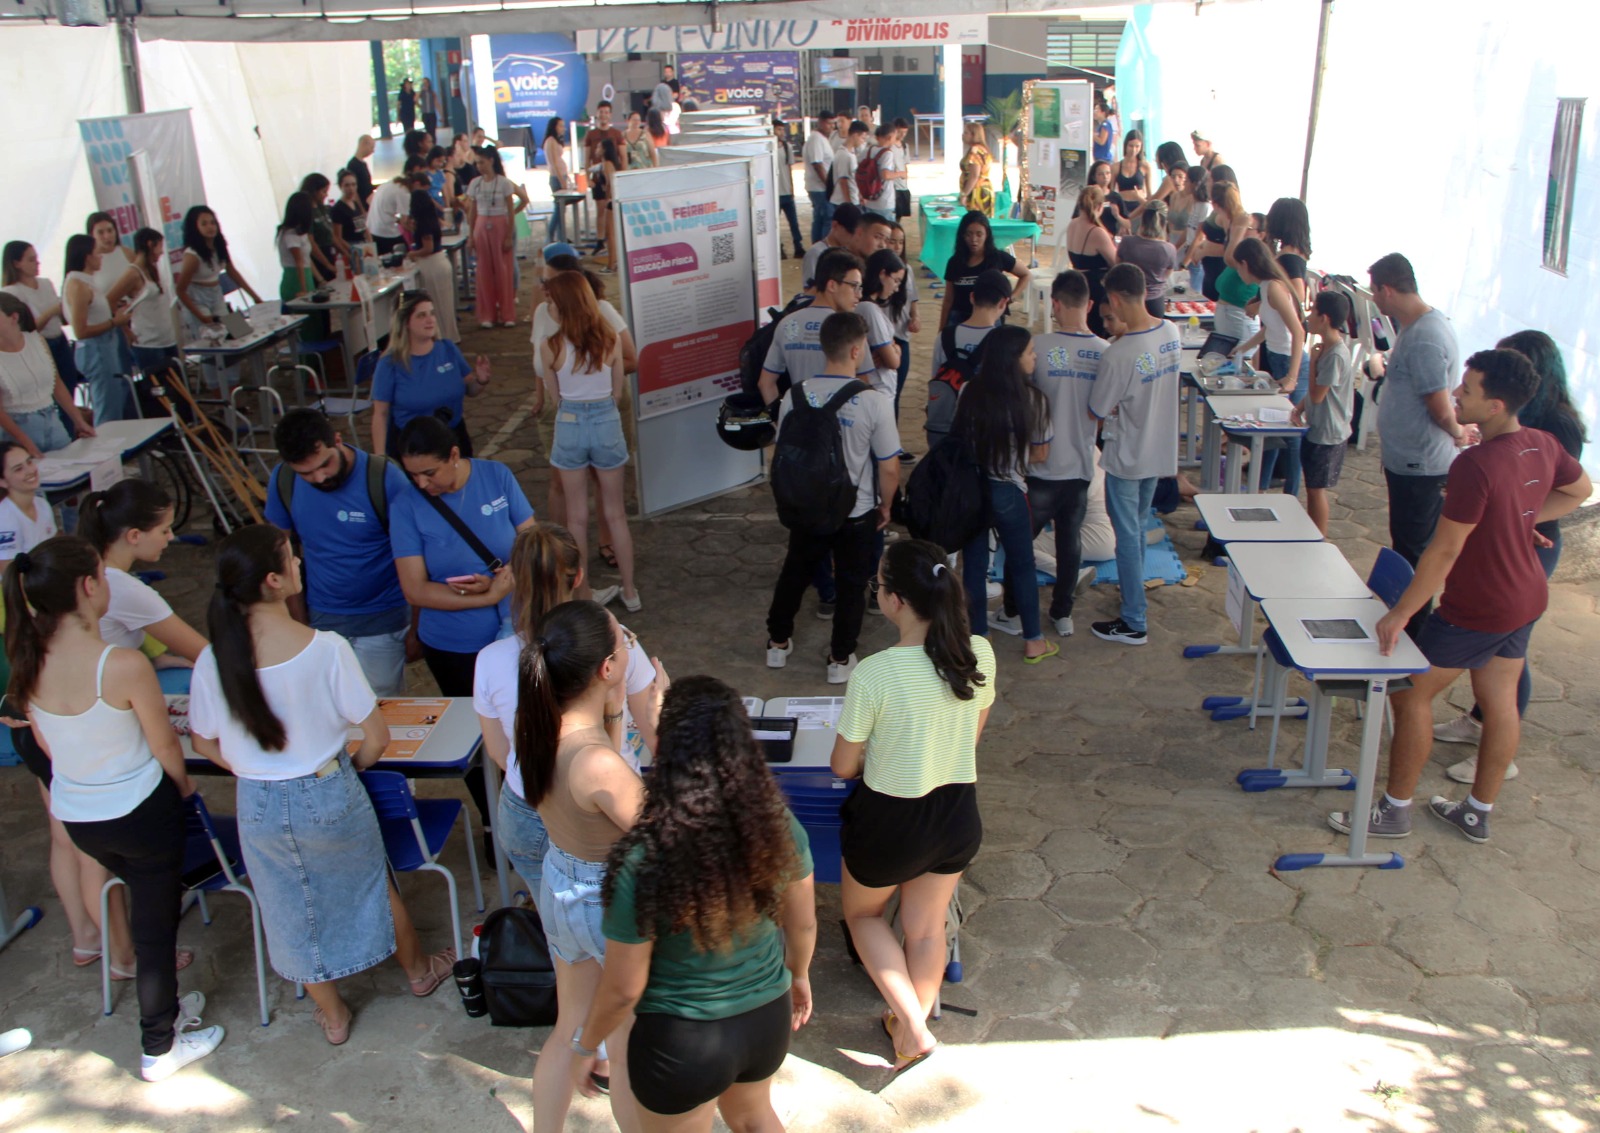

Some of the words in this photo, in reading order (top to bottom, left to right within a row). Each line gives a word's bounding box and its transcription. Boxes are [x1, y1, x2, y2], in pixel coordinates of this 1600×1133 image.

[845, 19, 949, 42] DIVINÓPOLIS
[633, 259, 671, 274] EDUCAÇÃO
[671, 255, 694, 267] FÍSICA
[1077, 349, 1099, 360] GEE
